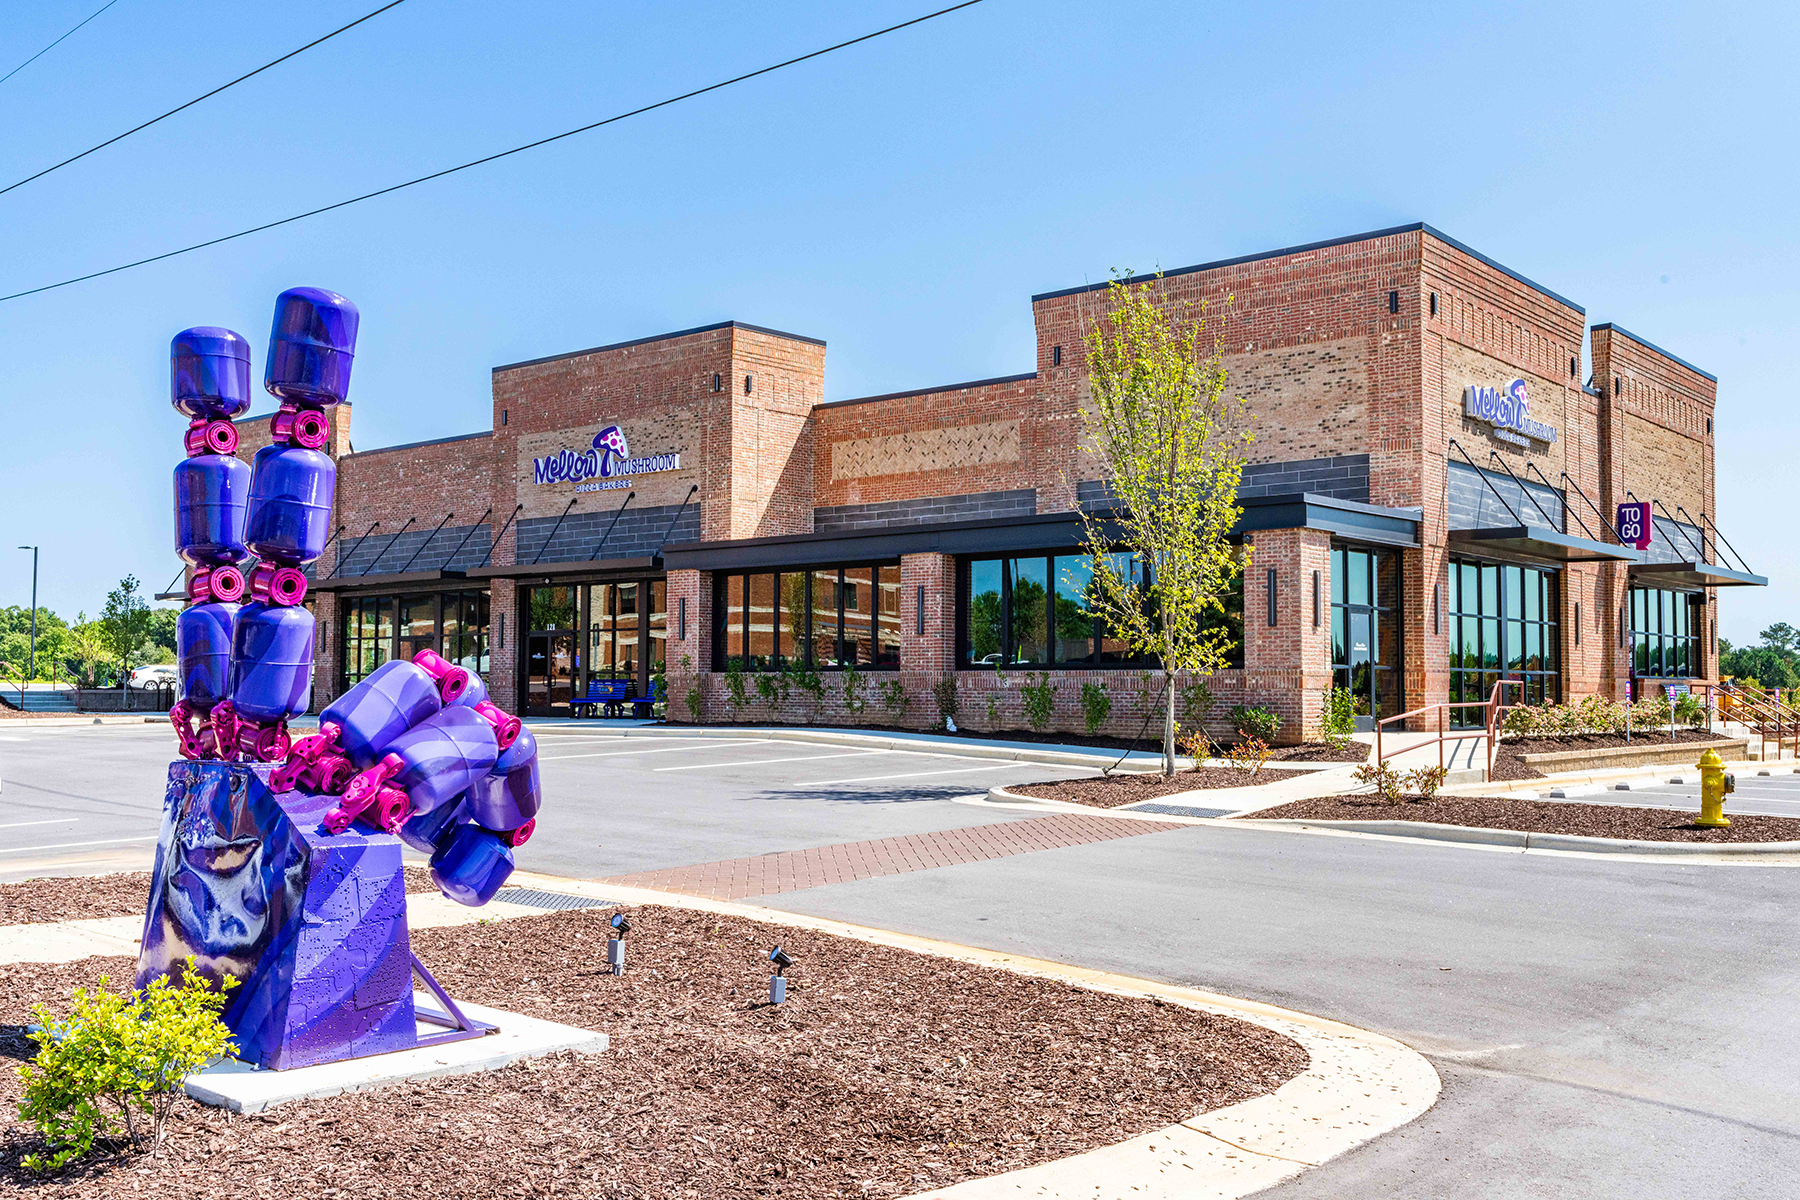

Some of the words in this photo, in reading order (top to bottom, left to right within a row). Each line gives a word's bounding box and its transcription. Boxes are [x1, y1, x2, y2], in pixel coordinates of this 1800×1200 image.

[1471, 385, 1515, 428] Mellow
[533, 449, 597, 485] Mellow
[614, 454, 678, 476] MUSHROOM
[576, 483, 597, 493] PIZZA
[598, 479, 631, 491] BAKERS
[1622, 507, 1640, 522] TO
[1622, 524, 1640, 538] GO
